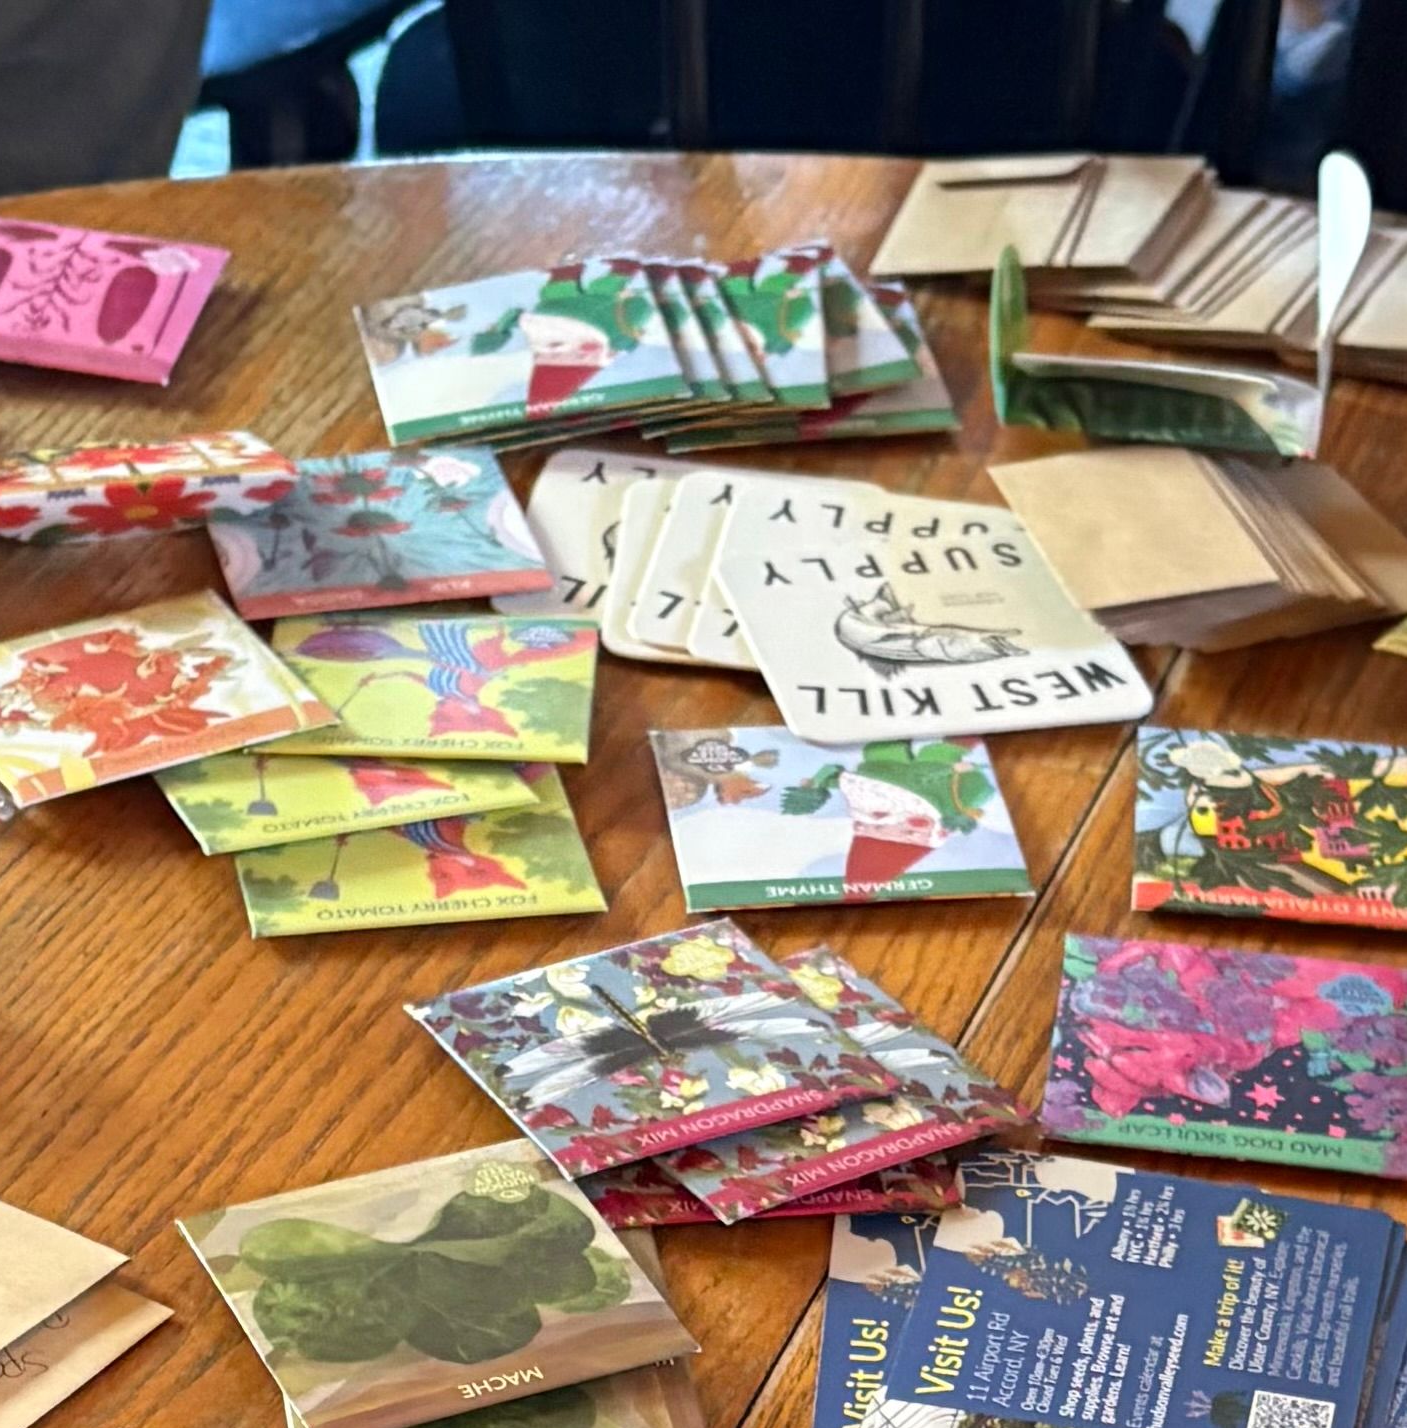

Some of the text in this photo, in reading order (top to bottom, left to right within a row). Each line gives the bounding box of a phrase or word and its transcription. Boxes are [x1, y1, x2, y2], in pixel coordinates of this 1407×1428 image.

[768, 498, 1026, 539] UPPLY
[764, 542, 1023, 586] SUPPLY
[797, 662, 1128, 717] WEST KILL
[440, 792, 471, 804] FOX
[262, 813, 345, 834] TOMATO
[316, 894, 538, 921] FOX CHERRY TOMATO
[765, 879, 934, 898] GERMAN THYME
[638, 1088, 824, 1148] SNAPDRAGON MIX
[1118, 1123, 1343, 1158] MAD DOG SKULLCAP
[785, 1122, 962, 1188] SNAPDRAGON MIX
[1125, 1239, 1143, 1264] NYC
[1202, 1257, 1246, 1367] Make trip of it!
[1228, 1270, 1267, 1371] Discover the beauty
[848, 1318, 890, 1363] Us!
[914, 1285, 984, 1394] Visit Us!
[966, 1311, 1011, 1402] 11 Airport Rd
[1058, 1296, 1105, 1418] Shop seeds, plants, and
[1081, 1293, 1126, 1421] supplies. Browse and
[1247, 1301, 1280, 1374] Ulster County,
[457, 1366, 545, 1399] MACHE
[991, 1330, 1030, 1407] Accord, NY
[1101, 1343, 1132, 1425] gardens. Learn!
[1138, 1346, 1160, 1392] calendar
[1020, 1391, 1038, 1411] Open
[1035, 1382, 1054, 1414] Closed
